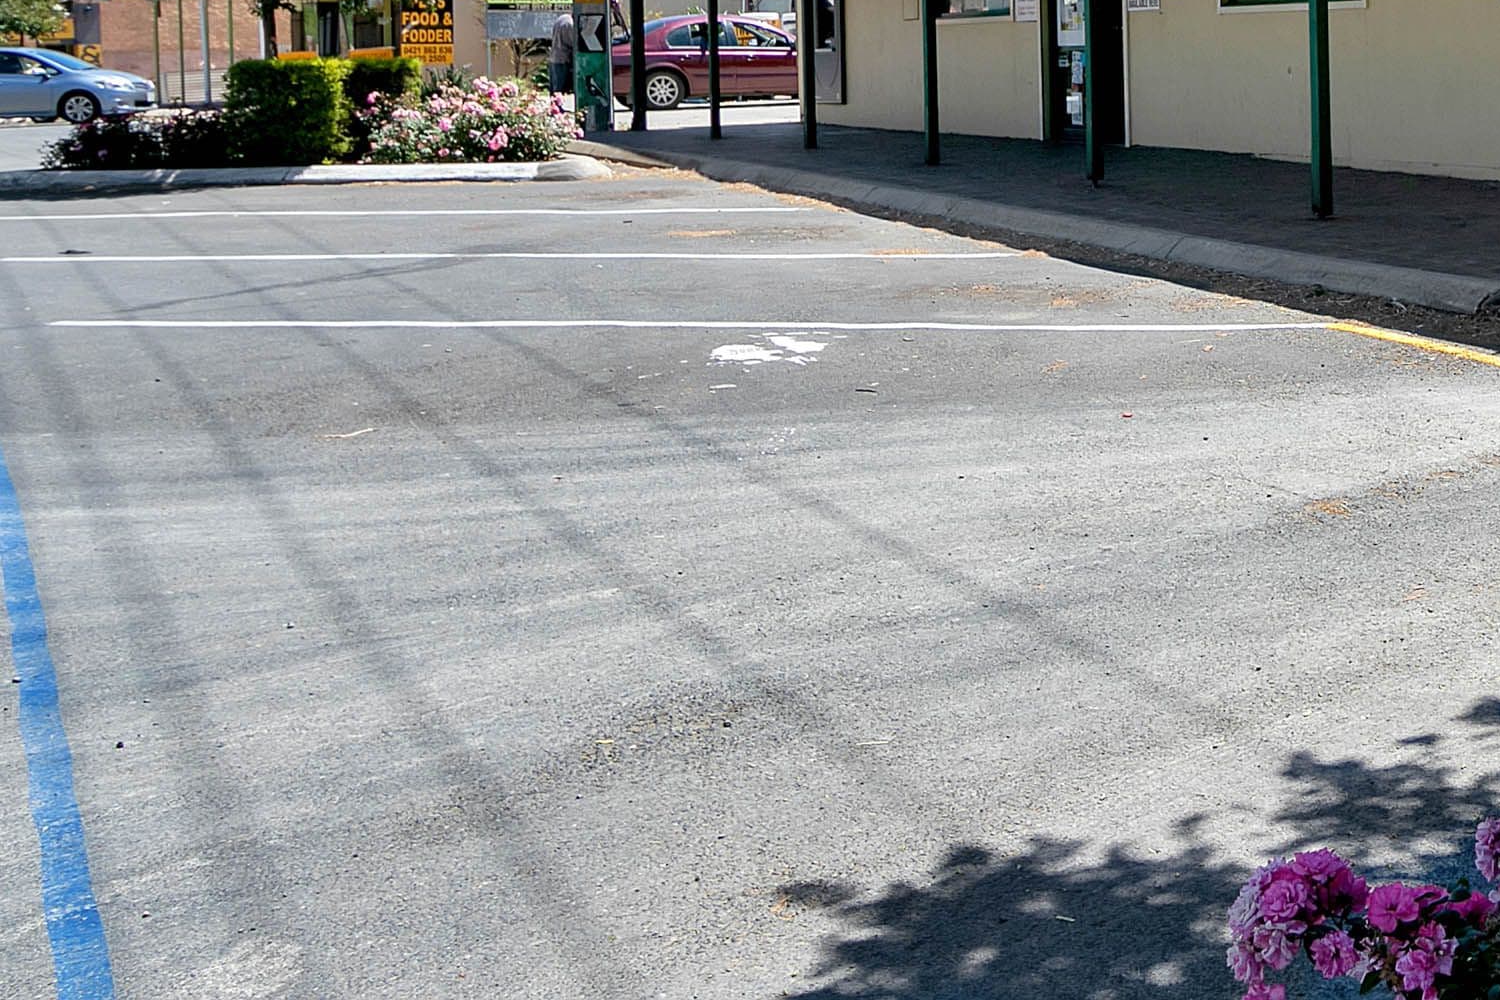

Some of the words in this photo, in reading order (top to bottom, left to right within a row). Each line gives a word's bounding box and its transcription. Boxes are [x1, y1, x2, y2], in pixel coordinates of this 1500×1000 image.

[401, 11, 440, 27] FOOD
[442, 11, 453, 27] &
[402, 28, 452, 43] FODDER
